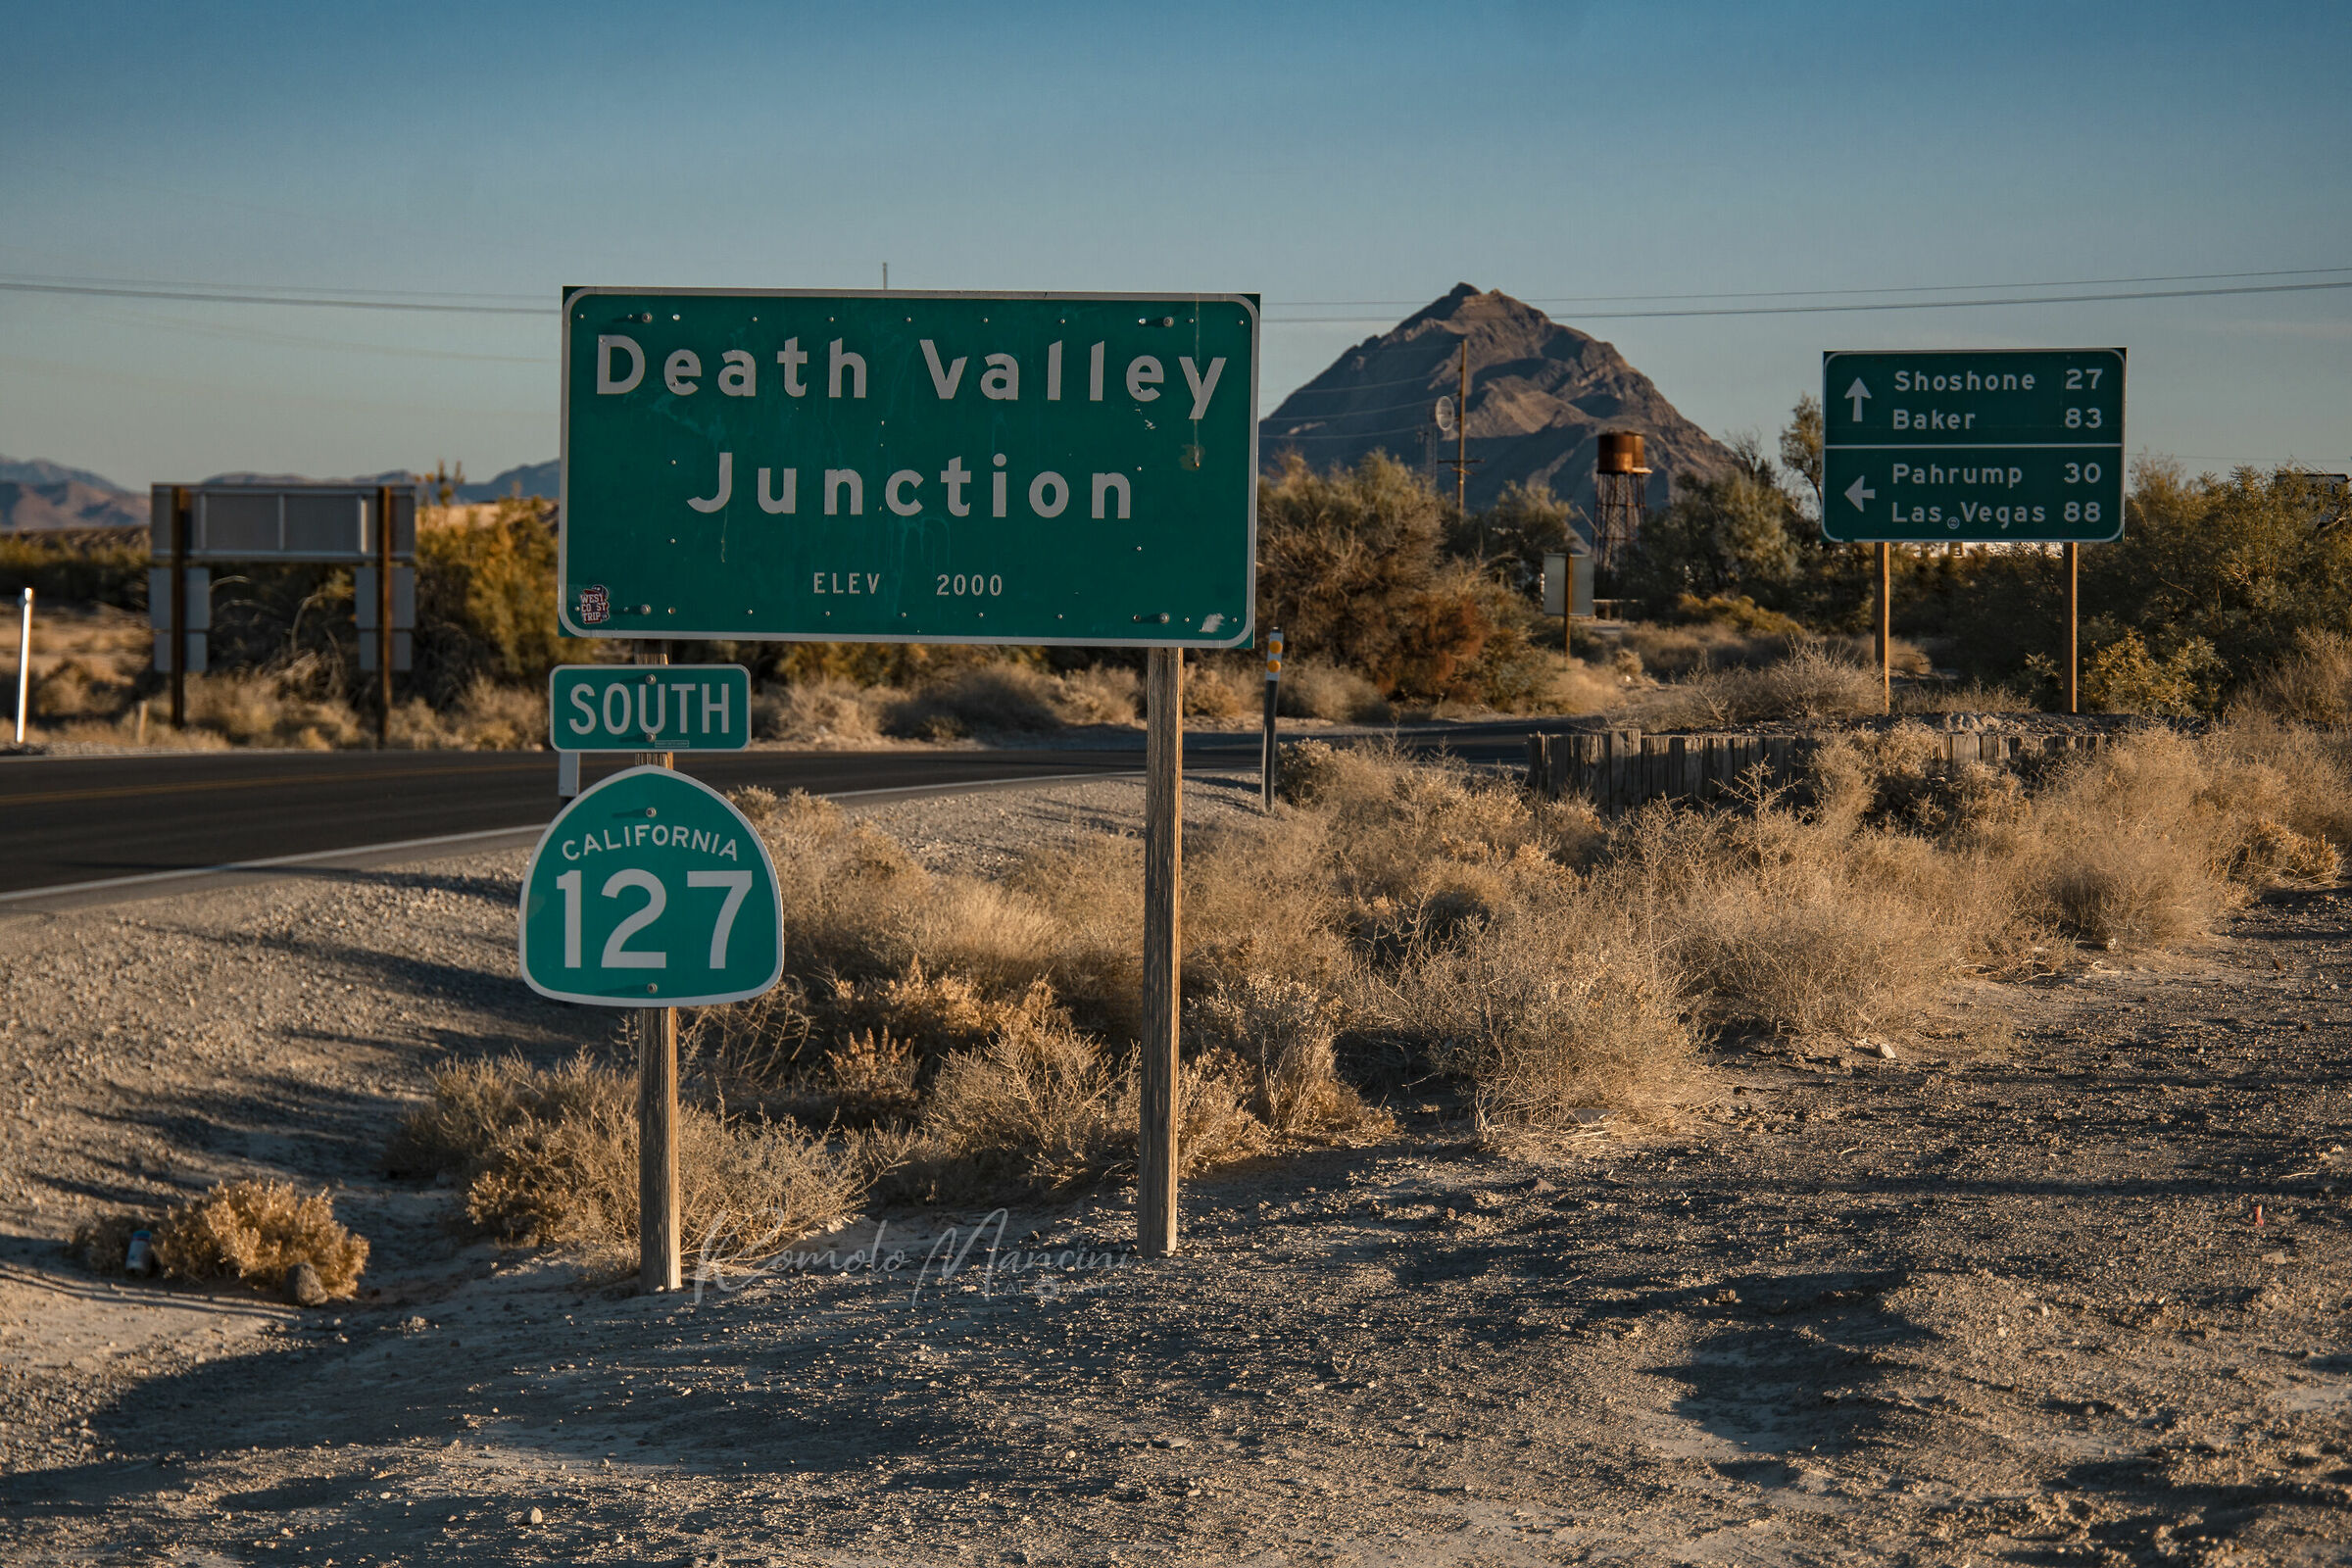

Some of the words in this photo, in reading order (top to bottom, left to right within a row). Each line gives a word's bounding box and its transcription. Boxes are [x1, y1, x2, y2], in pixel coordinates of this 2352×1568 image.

[597, 335, 866, 399] Death
[920, 339, 1226, 419] Valley
[1894, 370, 2035, 391] Shoshone
[2065, 368, 2102, 390] 27
[1892, 410, 1976, 429] Baker
[2065, 408, 2102, 429] 83
[688, 453, 1131, 519] Junction
[1892, 464, 2022, 488] Pahrump
[2064, 463, 2101, 483] 30
[1892, 502, 1941, 522] Las
[1960, 502, 2045, 529] Vegas
[2064, 502, 2101, 522] 88
[813, 572, 880, 595] ELEV
[936, 574, 1003, 596] 2000
[580, 594, 604, 604] WEST
[581, 602, 607, 612] COST
[582, 612, 601, 621] TRIP
[568, 683, 729, 735] SOUTH
[563, 824, 738, 861] CALIFORNIA
[557, 868, 753, 969] 127
